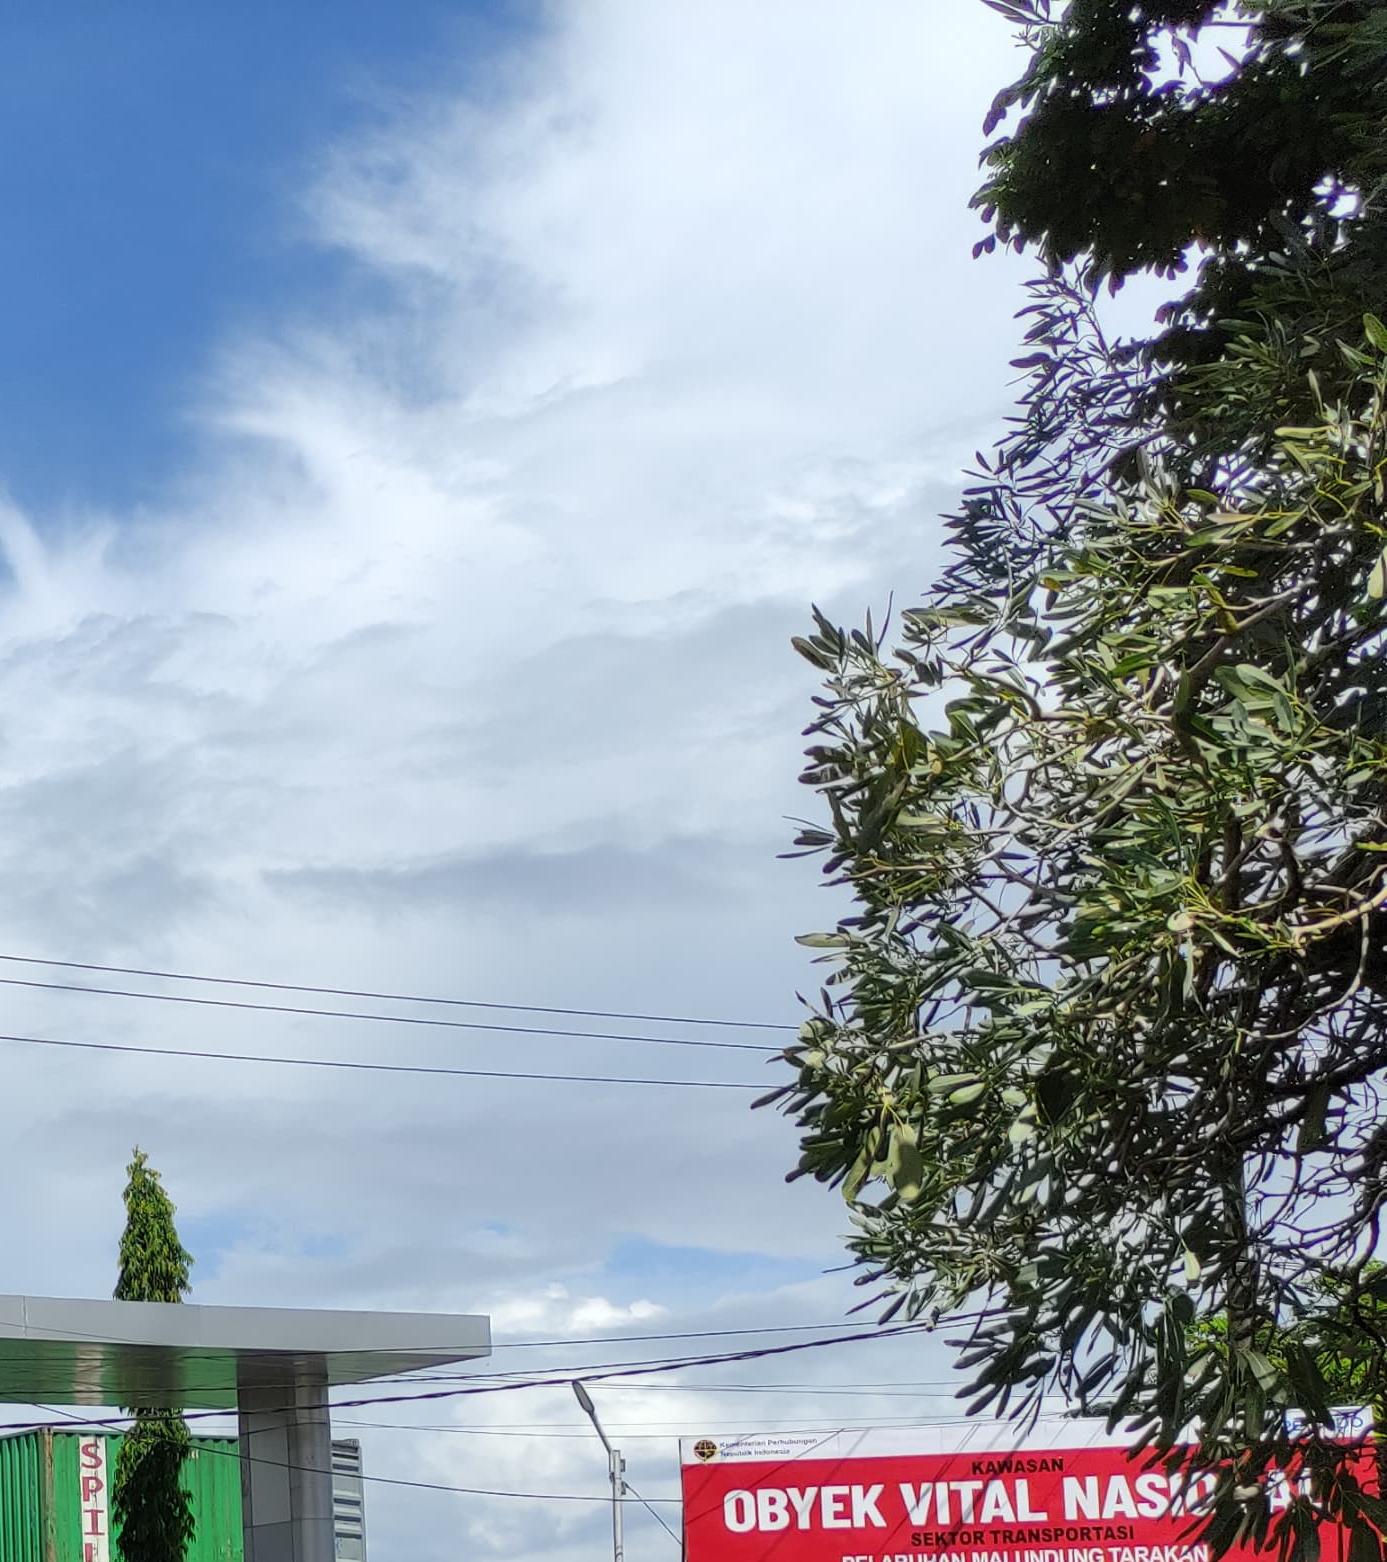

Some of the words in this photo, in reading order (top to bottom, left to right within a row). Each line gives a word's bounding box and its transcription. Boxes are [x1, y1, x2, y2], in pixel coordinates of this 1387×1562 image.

[971, 1458, 1065, 1476] KAWASAN
[723, 1483, 888, 1533] OBYEK
[899, 1478, 1049, 1526] VITAL
[1062, 1467, 1323, 1521] NASIOAL
[910, 1530, 985, 1548] SEKTOR
[989, 1526, 1135, 1545] TRANSPORTASI
